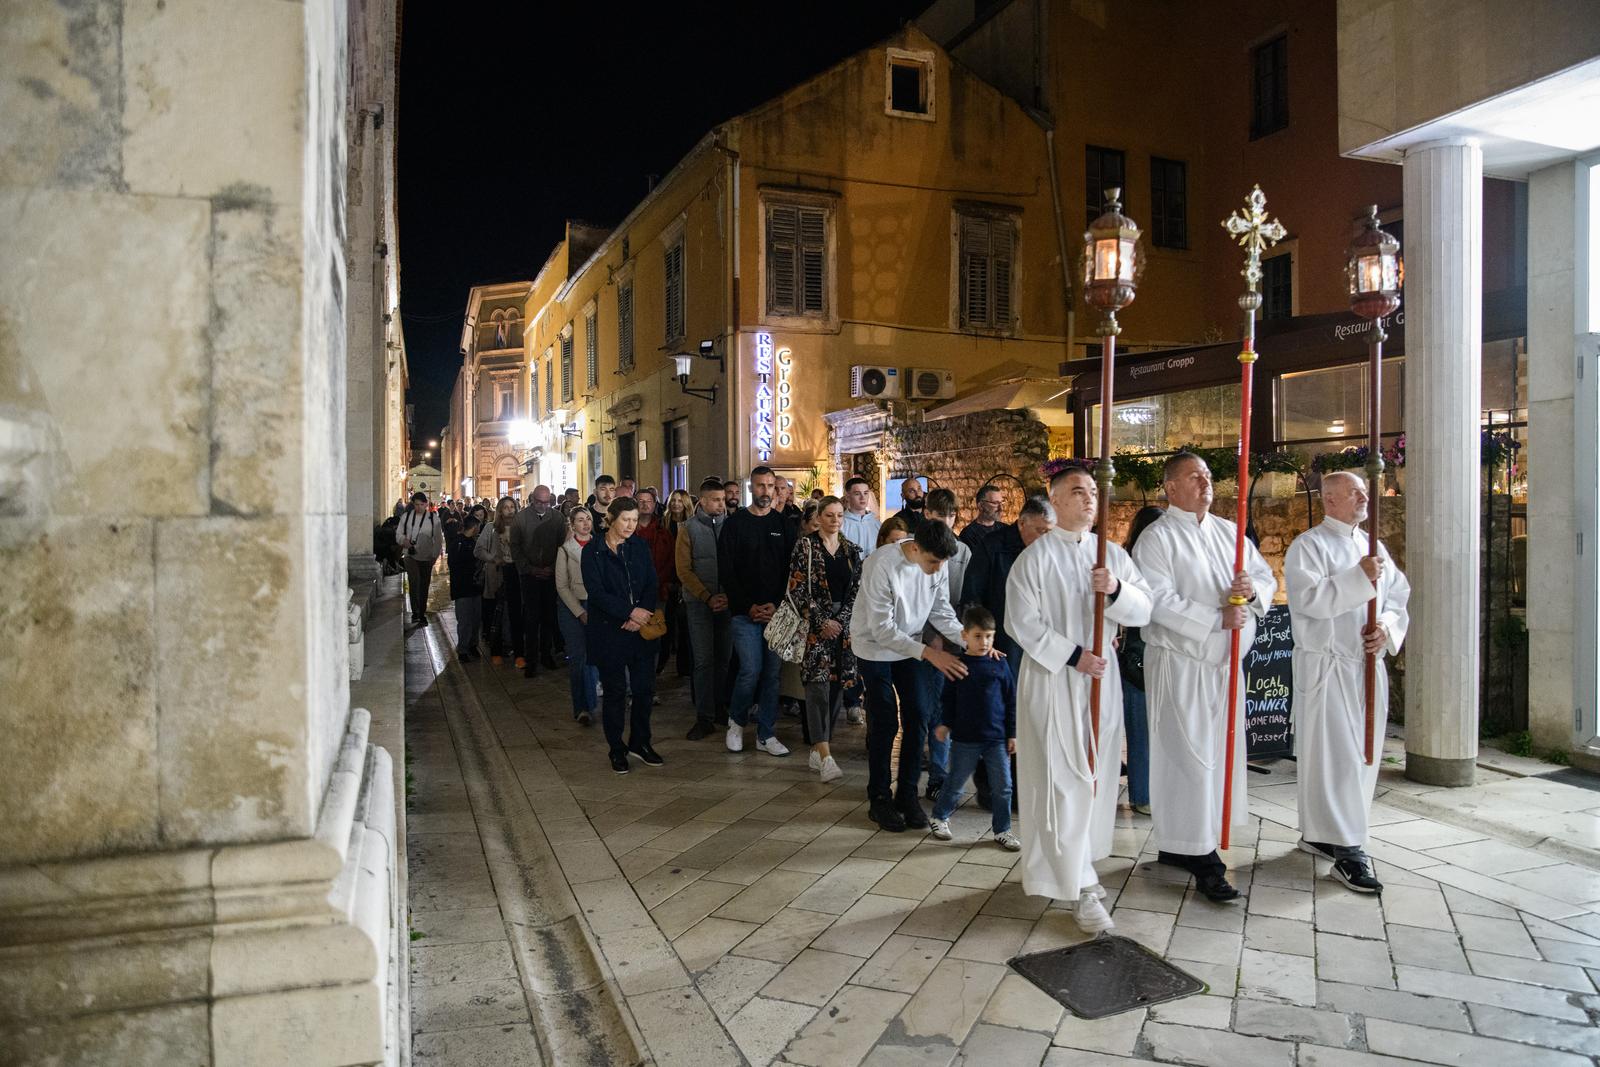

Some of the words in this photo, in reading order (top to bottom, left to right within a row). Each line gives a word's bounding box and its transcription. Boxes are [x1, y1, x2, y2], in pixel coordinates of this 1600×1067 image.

[1334, 317, 1391, 340] Restaurnt
[1130, 361, 1165, 379] Restaurant
[1167, 356, 1195, 369] Groppo
[759, 334, 771, 462] RESTAURANT
[779, 350, 790, 446] Groppo
[1246, 671, 1283, 694] LOCAL
[1264, 686, 1289, 700] FOOD
[1246, 698, 1288, 716] DINNER
[1251, 726, 1288, 746] Dessert
